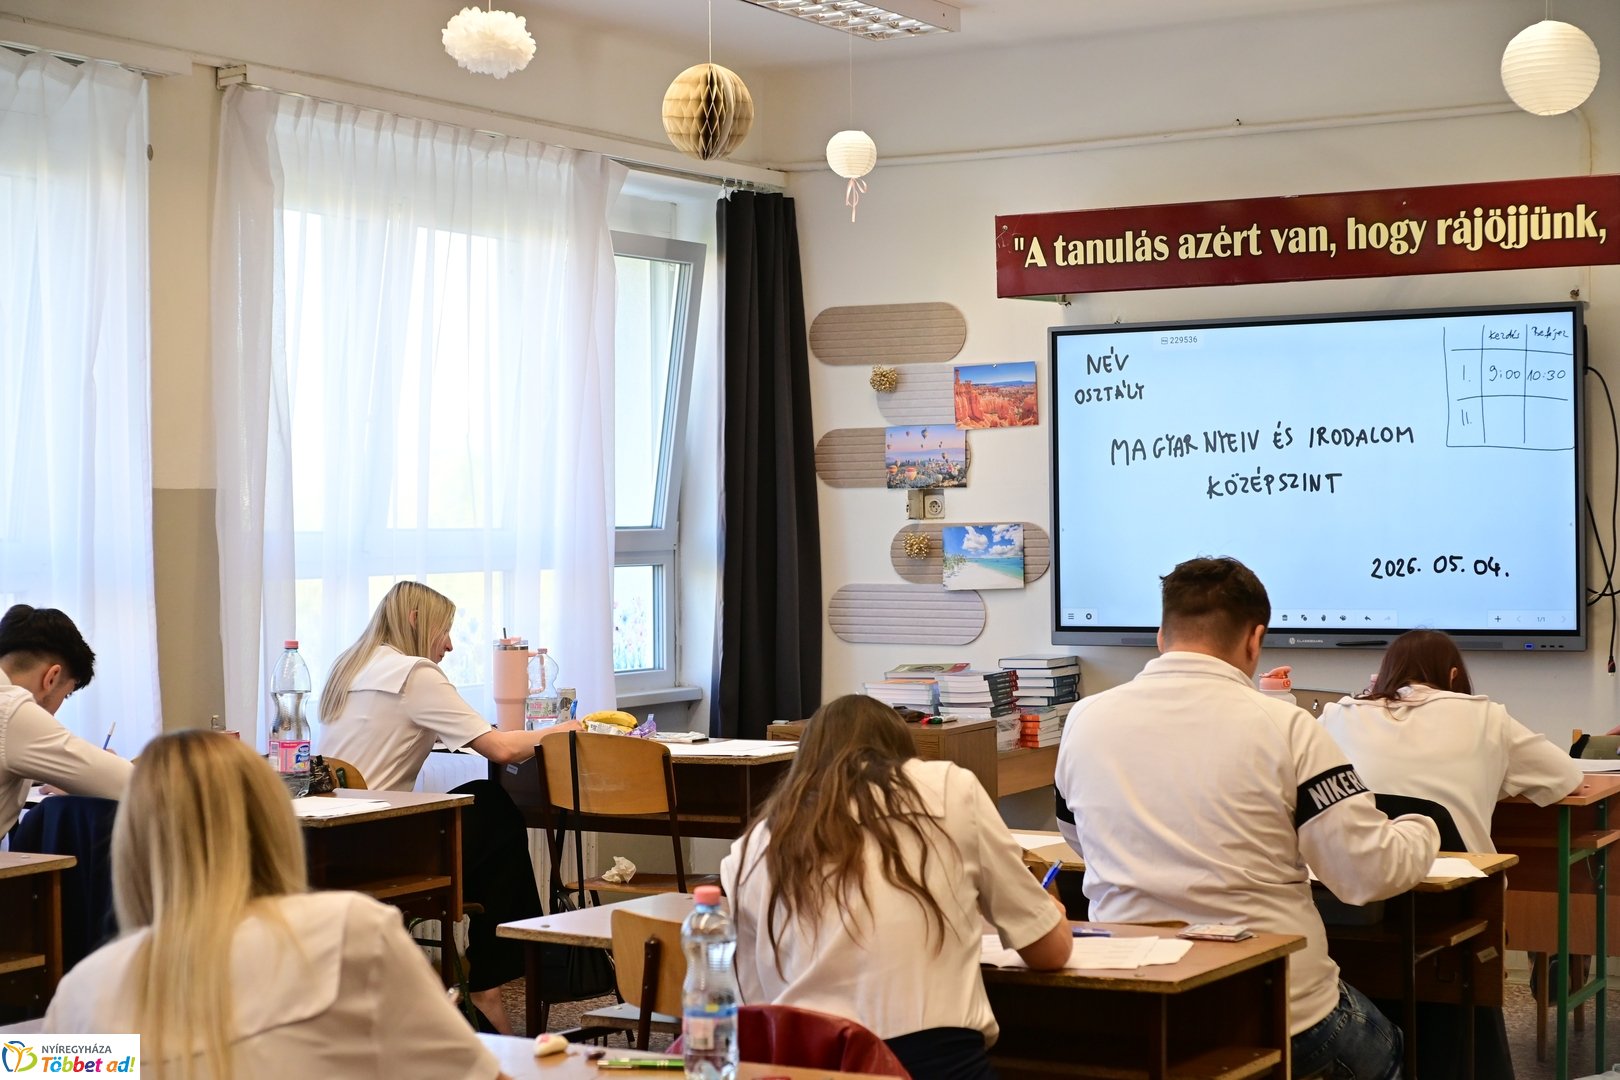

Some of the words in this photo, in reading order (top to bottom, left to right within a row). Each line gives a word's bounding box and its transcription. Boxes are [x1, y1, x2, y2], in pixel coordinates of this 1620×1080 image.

[1015, 237, 1047, 267] "A
[1054, 230, 1169, 266] tanulás
[1179, 224, 1262, 259] azért
[1271, 226, 1335, 257] van,
[1348, 218, 1427, 254] hogy
[1438, 204, 1606, 251] rájöjjünk,
[1170, 336, 1197, 344] 229536
[1087, 346, 1129, 375] NÉV
[1489, 365, 1520, 381] 9:00
[1527, 370, 1566, 381] 10:30
[1074, 380, 1144, 405] OSZTÁLY
[1111, 434, 1198, 466] MAGYAR
[1273, 421, 1293, 449] ÉS
[1309, 426, 1414, 448] IRODALOM
[1207, 466, 1342, 499] KÖZÉPSZINT
[1371, 557, 1421, 579] 2026.
[1433, 555, 1465, 573] 05.
[1474, 556, 1509, 577] 04.
